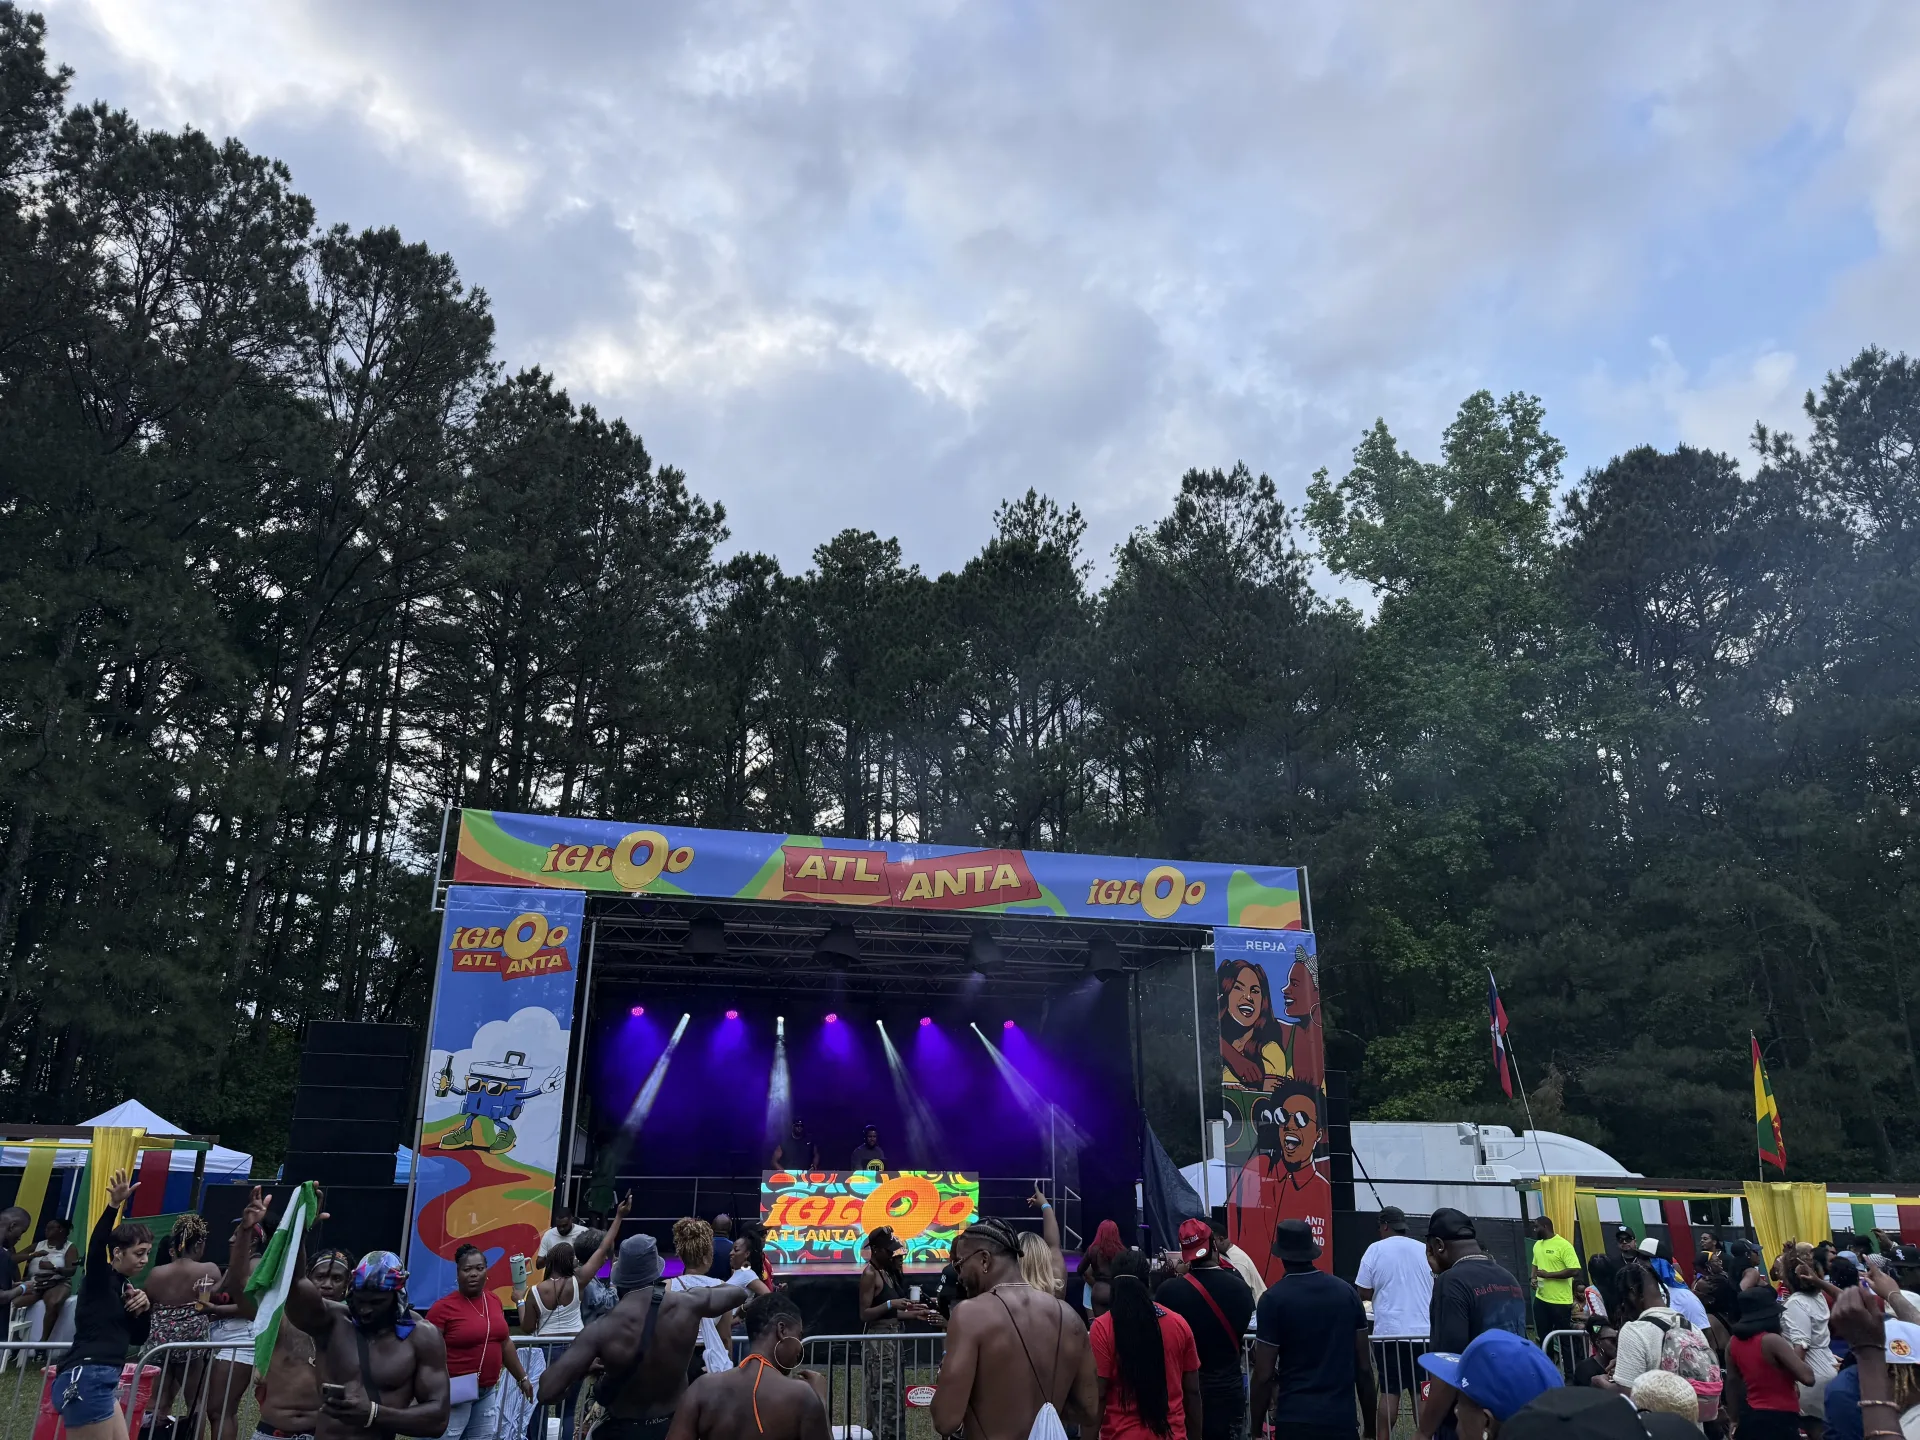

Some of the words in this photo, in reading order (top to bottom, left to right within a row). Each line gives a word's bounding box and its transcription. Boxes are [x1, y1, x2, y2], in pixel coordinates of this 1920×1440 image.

[794, 855, 880, 882] ATL
[901, 863, 1022, 901] ANTA
[1245, 940, 1287, 952] REPJA
[458, 954, 497, 966] ATL
[506, 954, 563, 974] ANTA
[1304, 1215, 1325, 1226] ANTI
[765, 1229, 857, 1242] ATLANTA
[1311, 1226, 1323, 1235] AD
